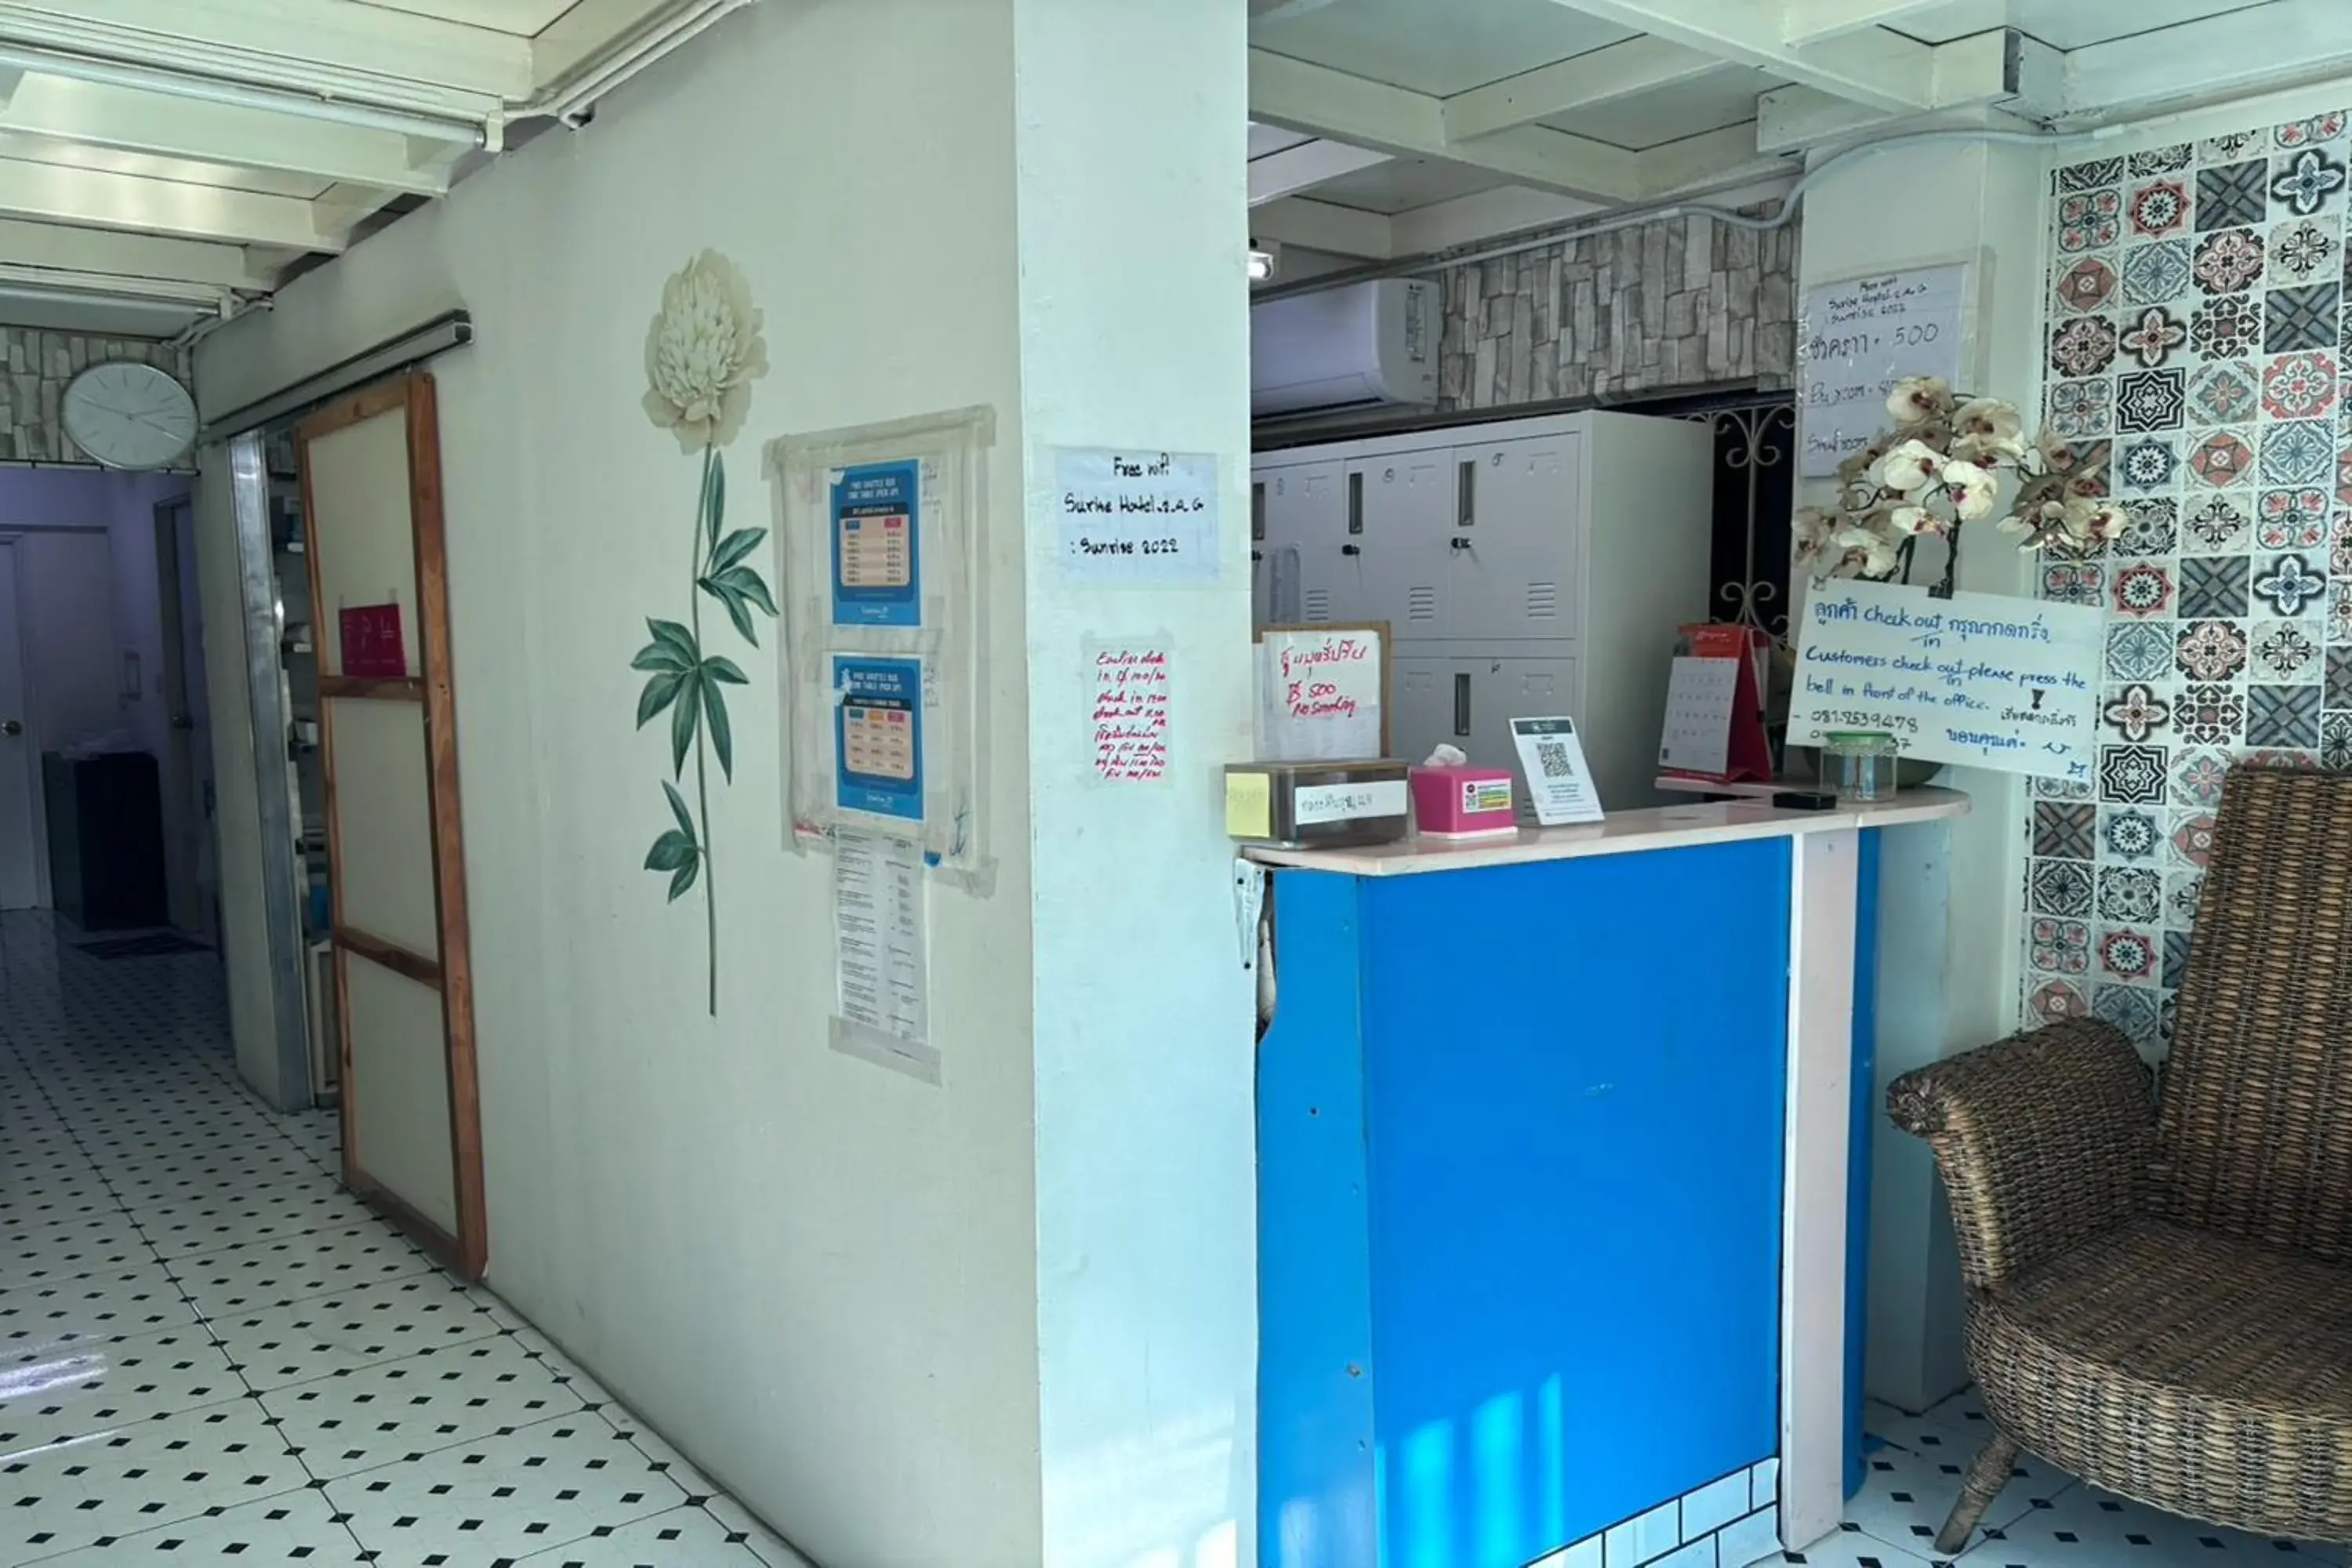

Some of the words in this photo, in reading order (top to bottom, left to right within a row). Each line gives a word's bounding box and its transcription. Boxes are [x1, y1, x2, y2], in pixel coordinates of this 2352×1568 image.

[1893, 323, 1939, 347] 500
[1113, 456, 1143, 477] Free
[1080, 538, 1134, 554] Sunrise
[1142, 538, 1178, 554] 2022
[1864, 604, 1911, 627] check
[1914, 614, 1944, 629] out
[1806, 644, 1887, 667] Customers
[1892, 655, 1933, 672] check
[1968, 662, 2014, 681] please
[2019, 672, 2058, 688] press
[2061, 671, 2087, 689] the
[1308, 683, 1337, 699] 500
[1806, 673, 1834, 695] bell
[1842, 684, 1855, 697] in
[1897, 687, 1915, 702] of
[1917, 690, 1939, 705] the
